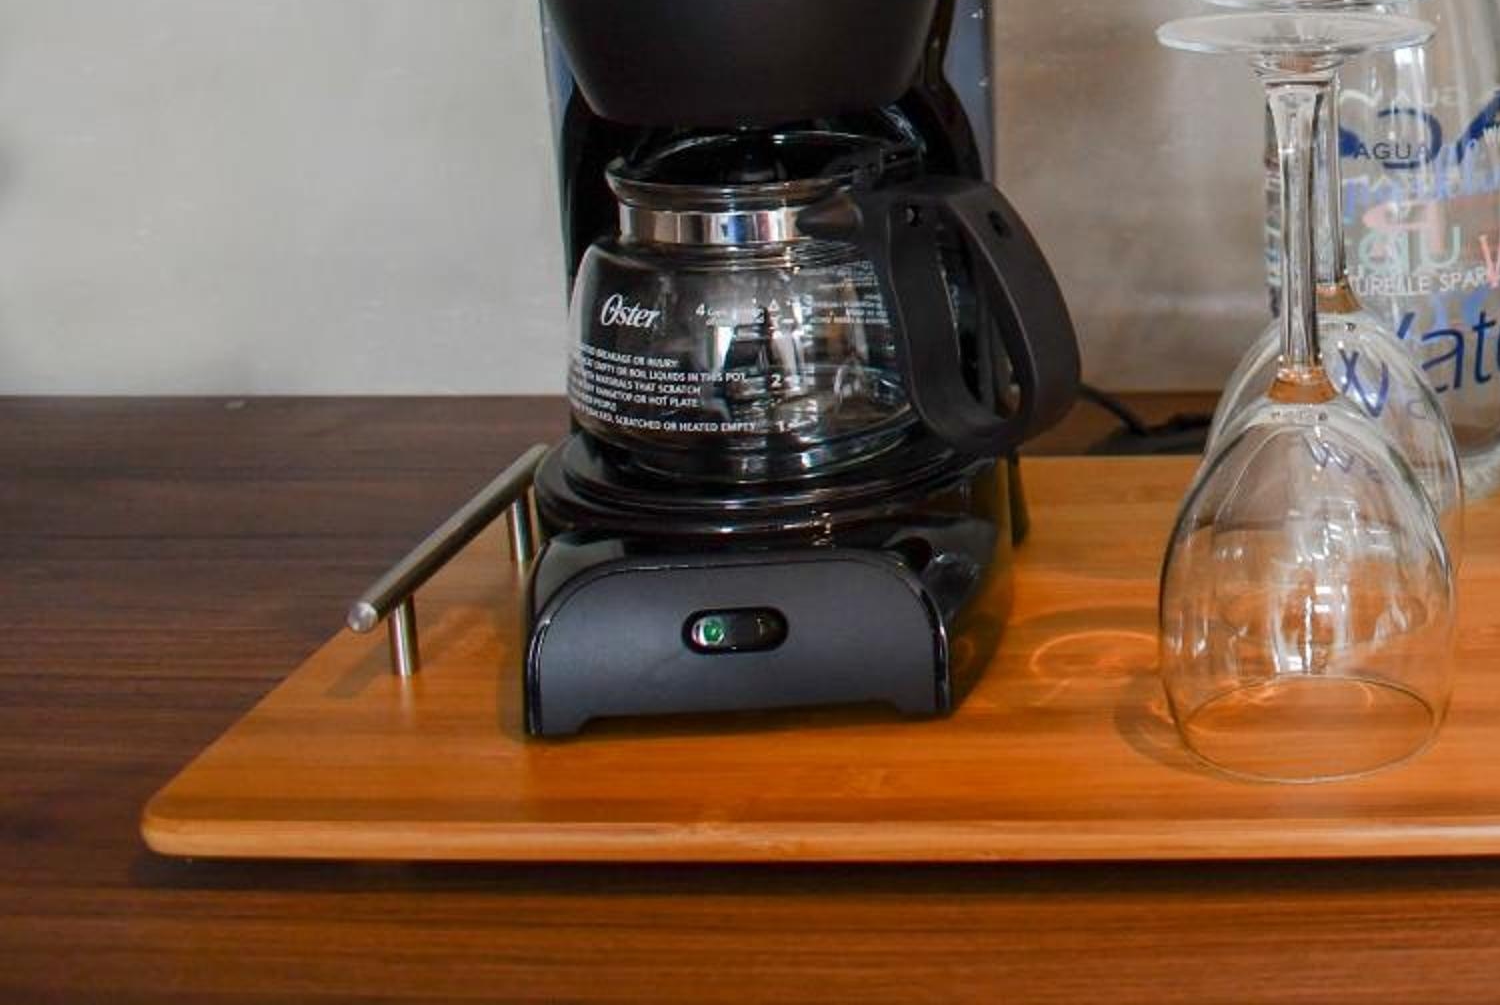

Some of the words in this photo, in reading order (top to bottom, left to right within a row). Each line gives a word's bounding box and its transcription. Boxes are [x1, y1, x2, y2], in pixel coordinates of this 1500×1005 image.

[601, 293, 661, 328] Oster
[649, 370, 686, 383] LIQUIDS
[688, 372, 699, 382] IN
[700, 372, 723, 383] THIS
[770, 373, 782, 388] 2
[635, 380, 656, 392] THAT
[648, 395, 668, 406] HOT
[663, 421, 677, 431] OR
[679, 422, 719, 432] HEATED
